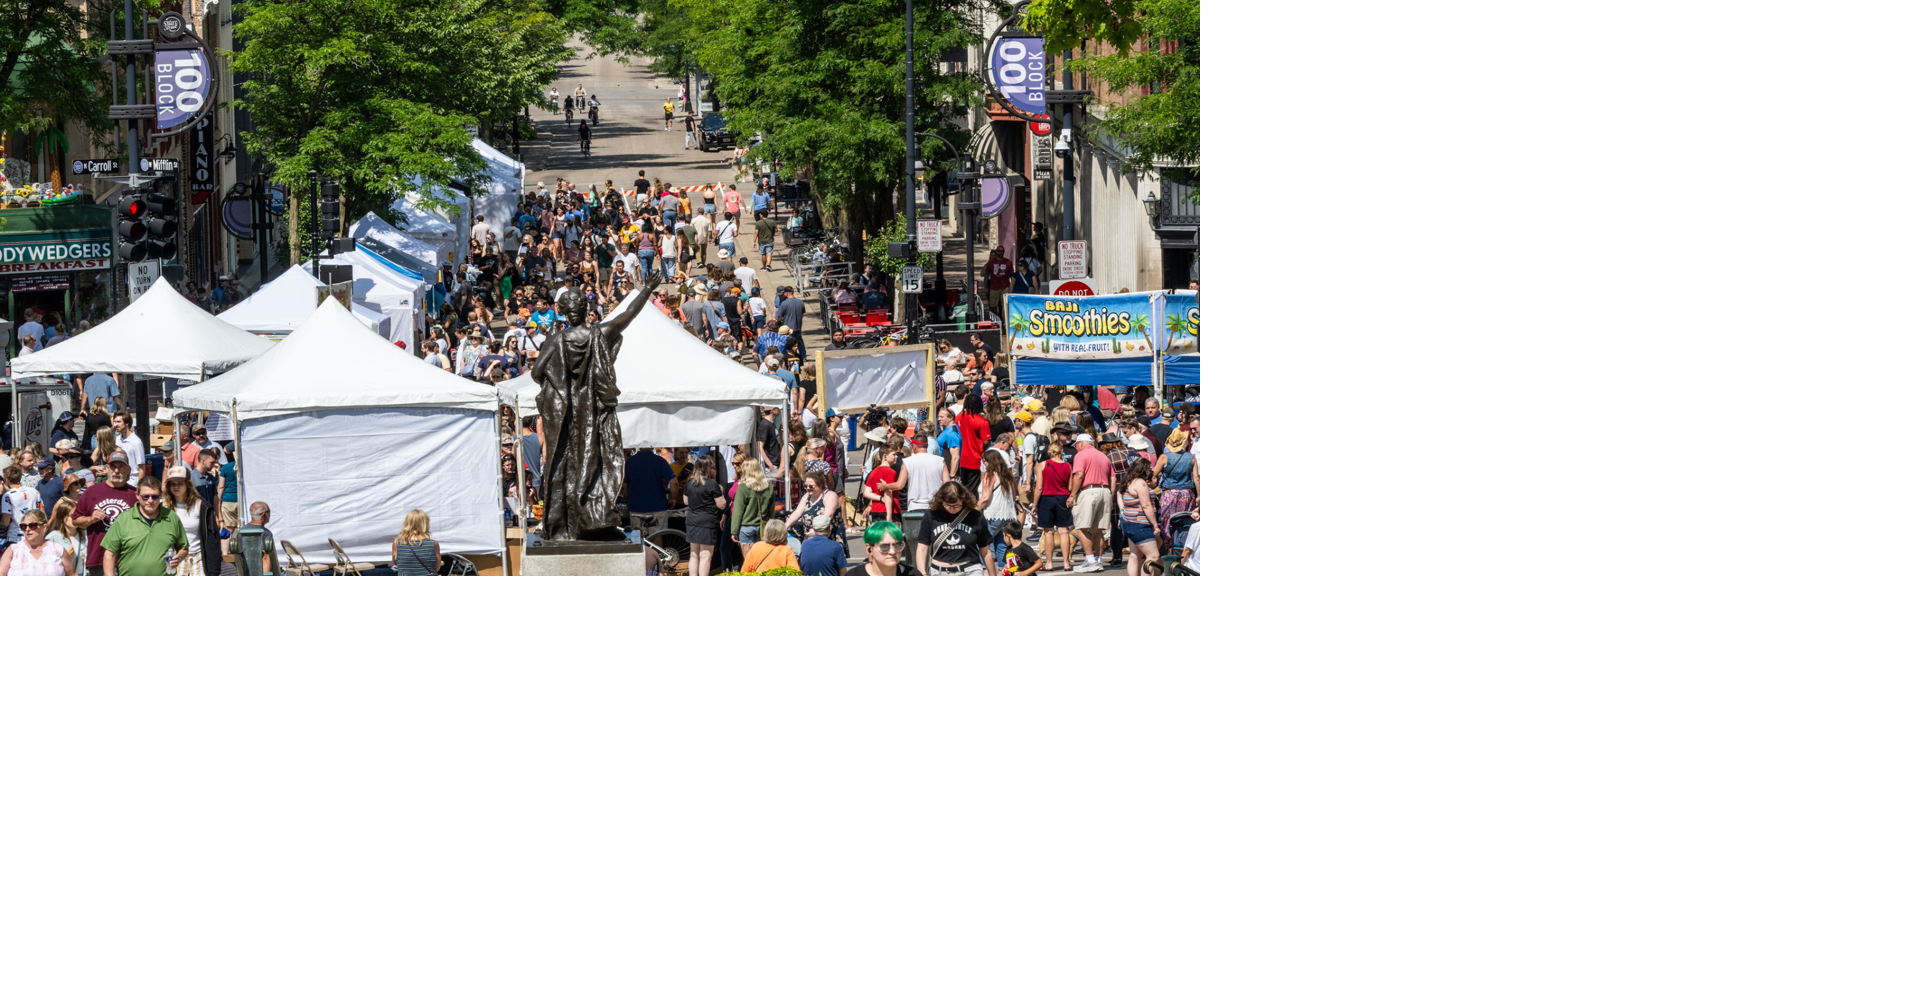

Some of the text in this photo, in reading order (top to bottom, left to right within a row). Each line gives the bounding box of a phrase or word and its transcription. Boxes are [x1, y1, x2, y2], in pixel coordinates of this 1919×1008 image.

[1000, 41, 1027, 99] 100
[1028, 51, 1043, 101] BLOCK
[174, 53, 204, 113] 100
[157, 64, 174, 115] BLOCK
[195, 117, 209, 182] PIANO
[87, 160, 112, 172] Carroll
[152, 159, 173, 171] Mifflin
[192, 183, 214, 191] BAR
[1069, 242, 1084, 250] TRUCK
[0, 243, 112, 263] DYWEDGERS
[0, 258, 107, 273] BREAKFAST
[137, 265, 148, 275] NO
[136, 275, 151, 285] TURN
[905, 279, 919, 290] 15
[133, 286, 141, 294] ON
[1045, 300, 1080, 313] BAJI
[1029, 306, 1131, 338] Smoothies
[1053, 342, 1110, 352] WITH REAL FRUIT!
